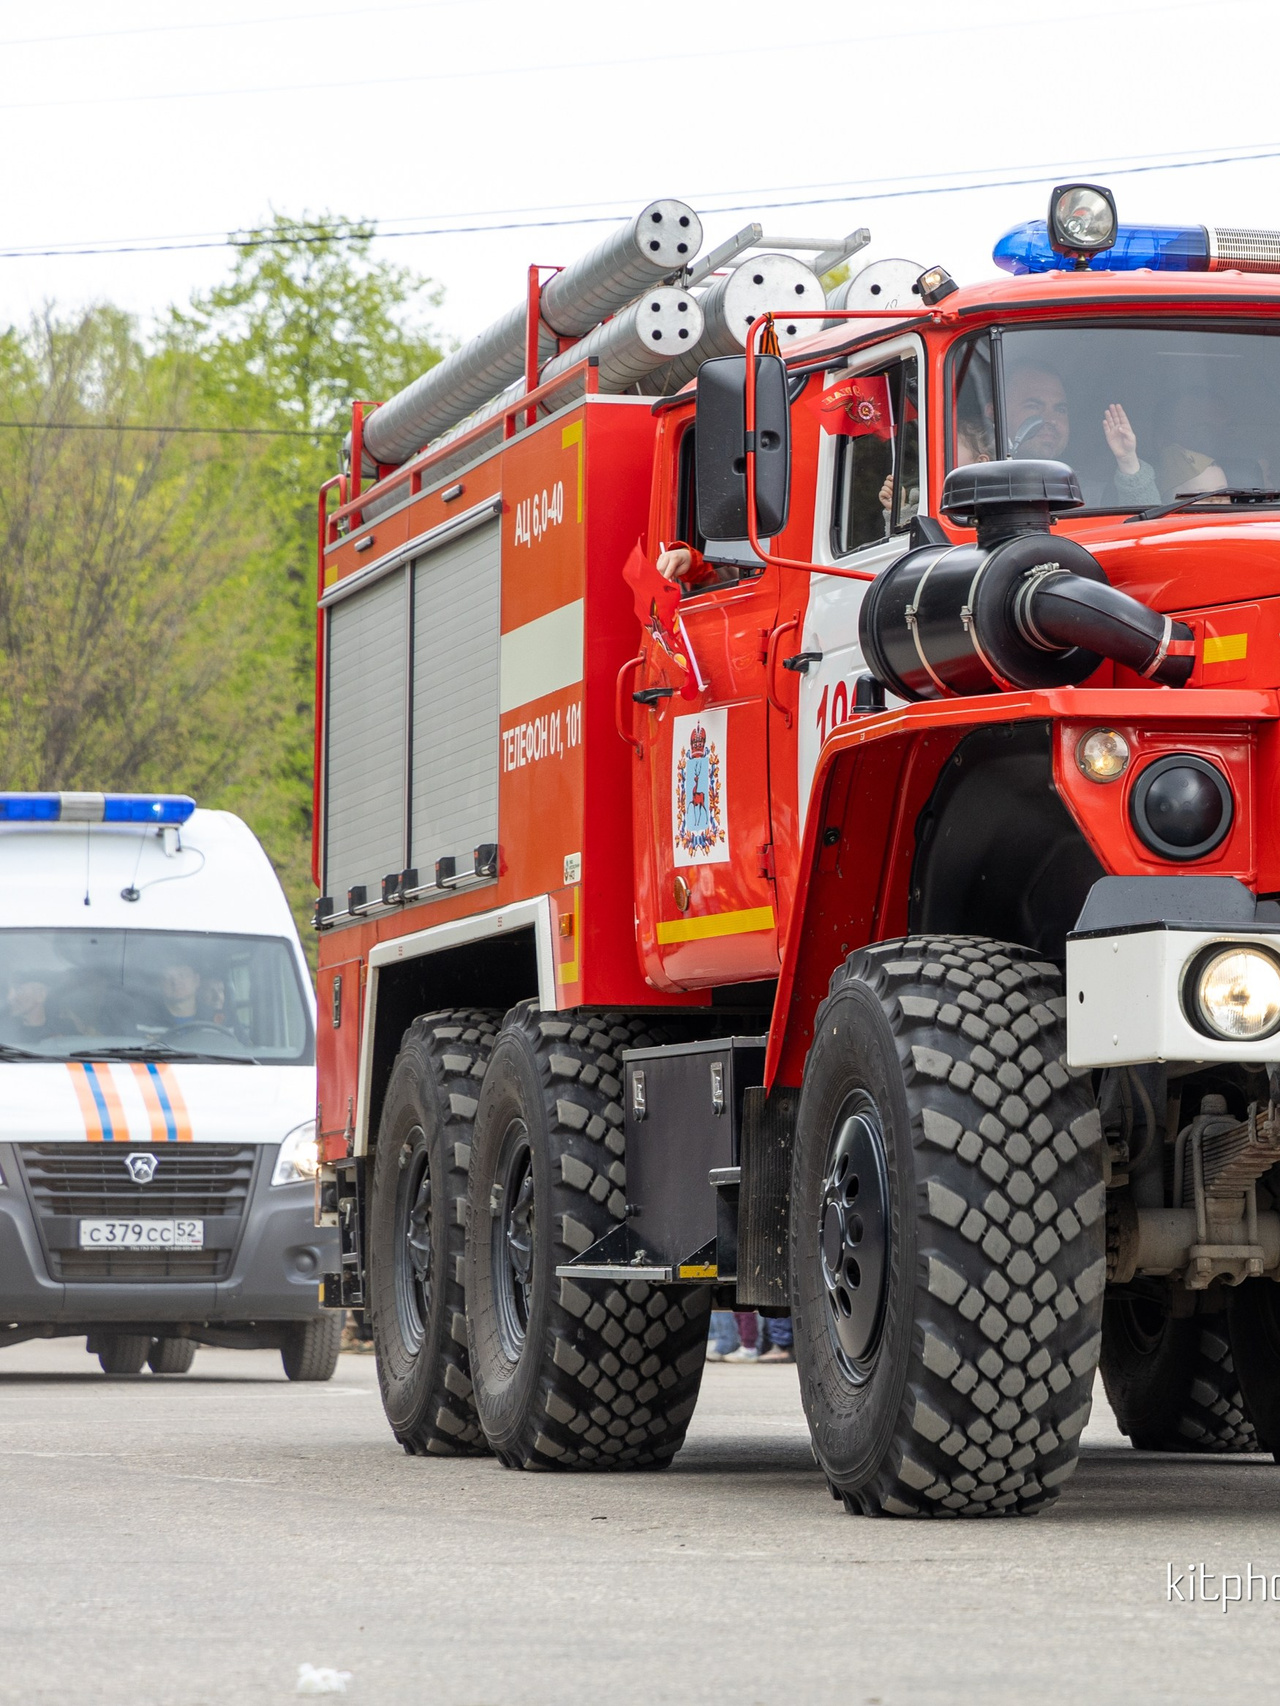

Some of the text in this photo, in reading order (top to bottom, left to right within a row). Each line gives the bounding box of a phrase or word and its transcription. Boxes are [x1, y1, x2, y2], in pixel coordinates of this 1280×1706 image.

[514, 480, 564, 548] АЦ 6,0-40
[502, 700, 582, 773] ТЕЛЕФОН 01, 101
[177, 1222, 196, 1238] 52
